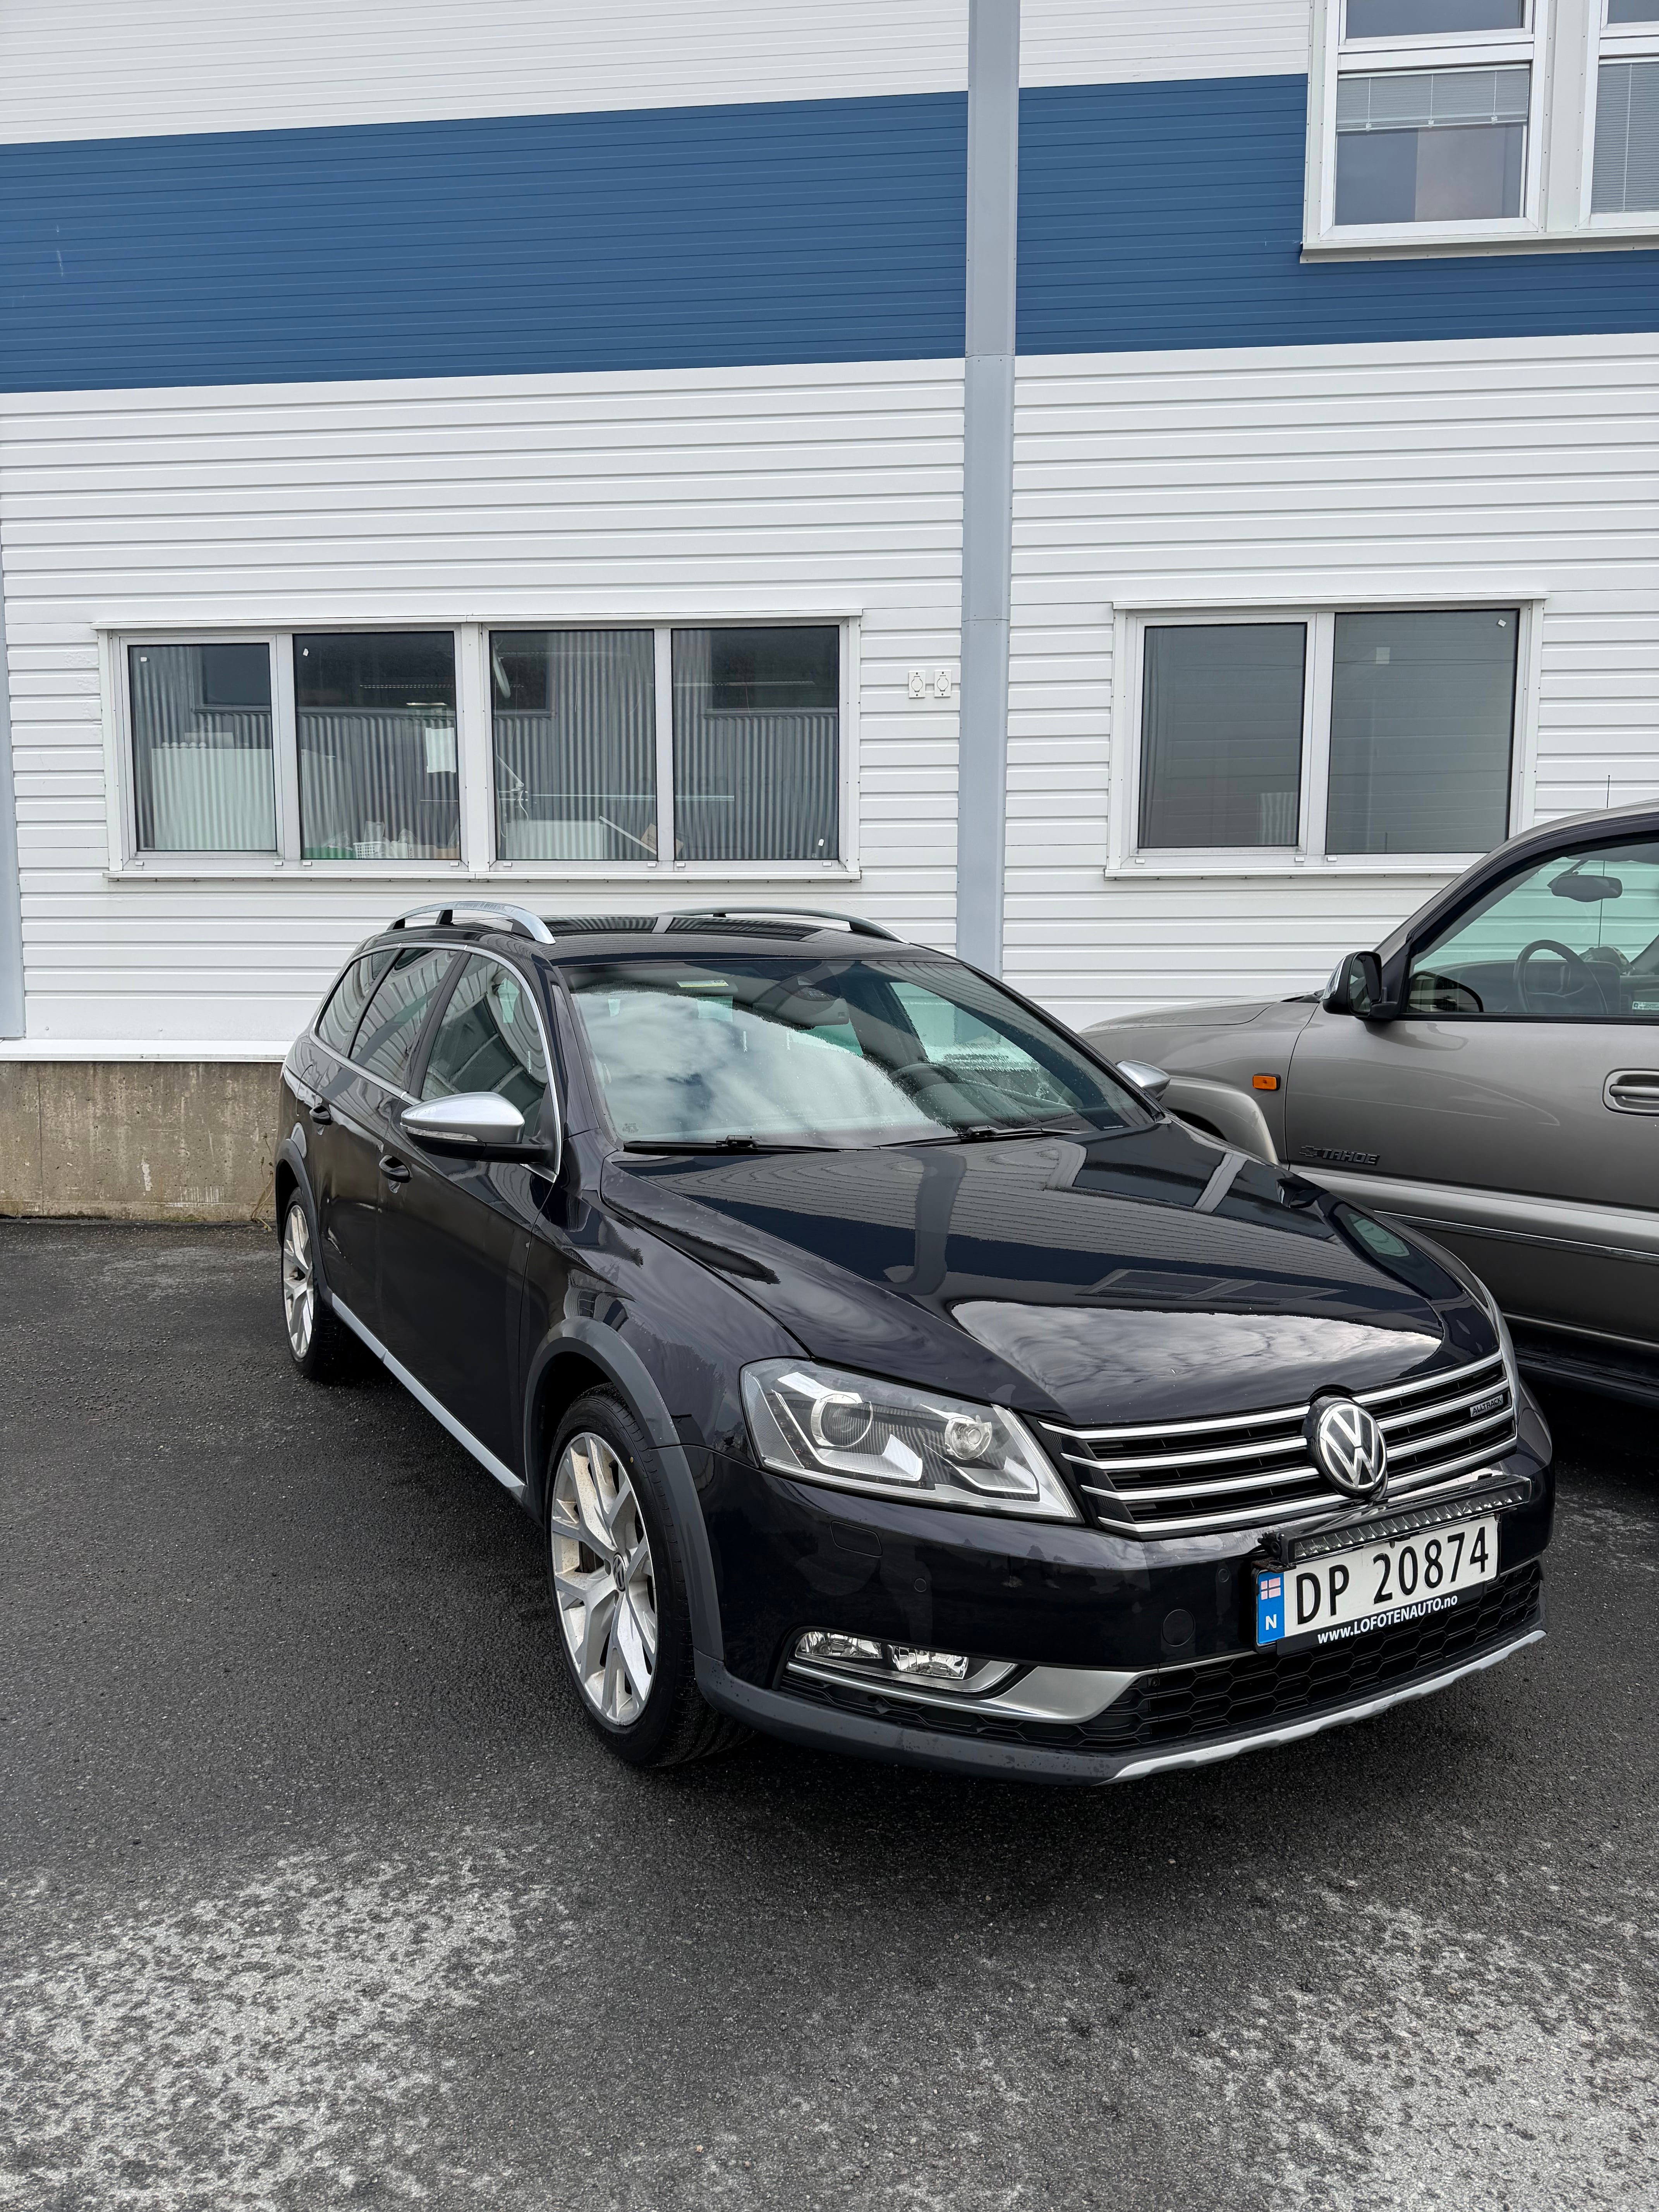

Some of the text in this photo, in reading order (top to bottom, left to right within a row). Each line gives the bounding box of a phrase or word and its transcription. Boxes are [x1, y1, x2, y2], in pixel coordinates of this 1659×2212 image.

[1322, 1148, 1378, 1164] TAHOE
[1473, 1396, 1502, 1415] ALLTRACK
[1296, 1526, 1489, 1625] DP 20874
[1265, 1613, 1277, 1630] N
[1317, 1595, 1458, 1644] www.LOFOTENAUTO.no
